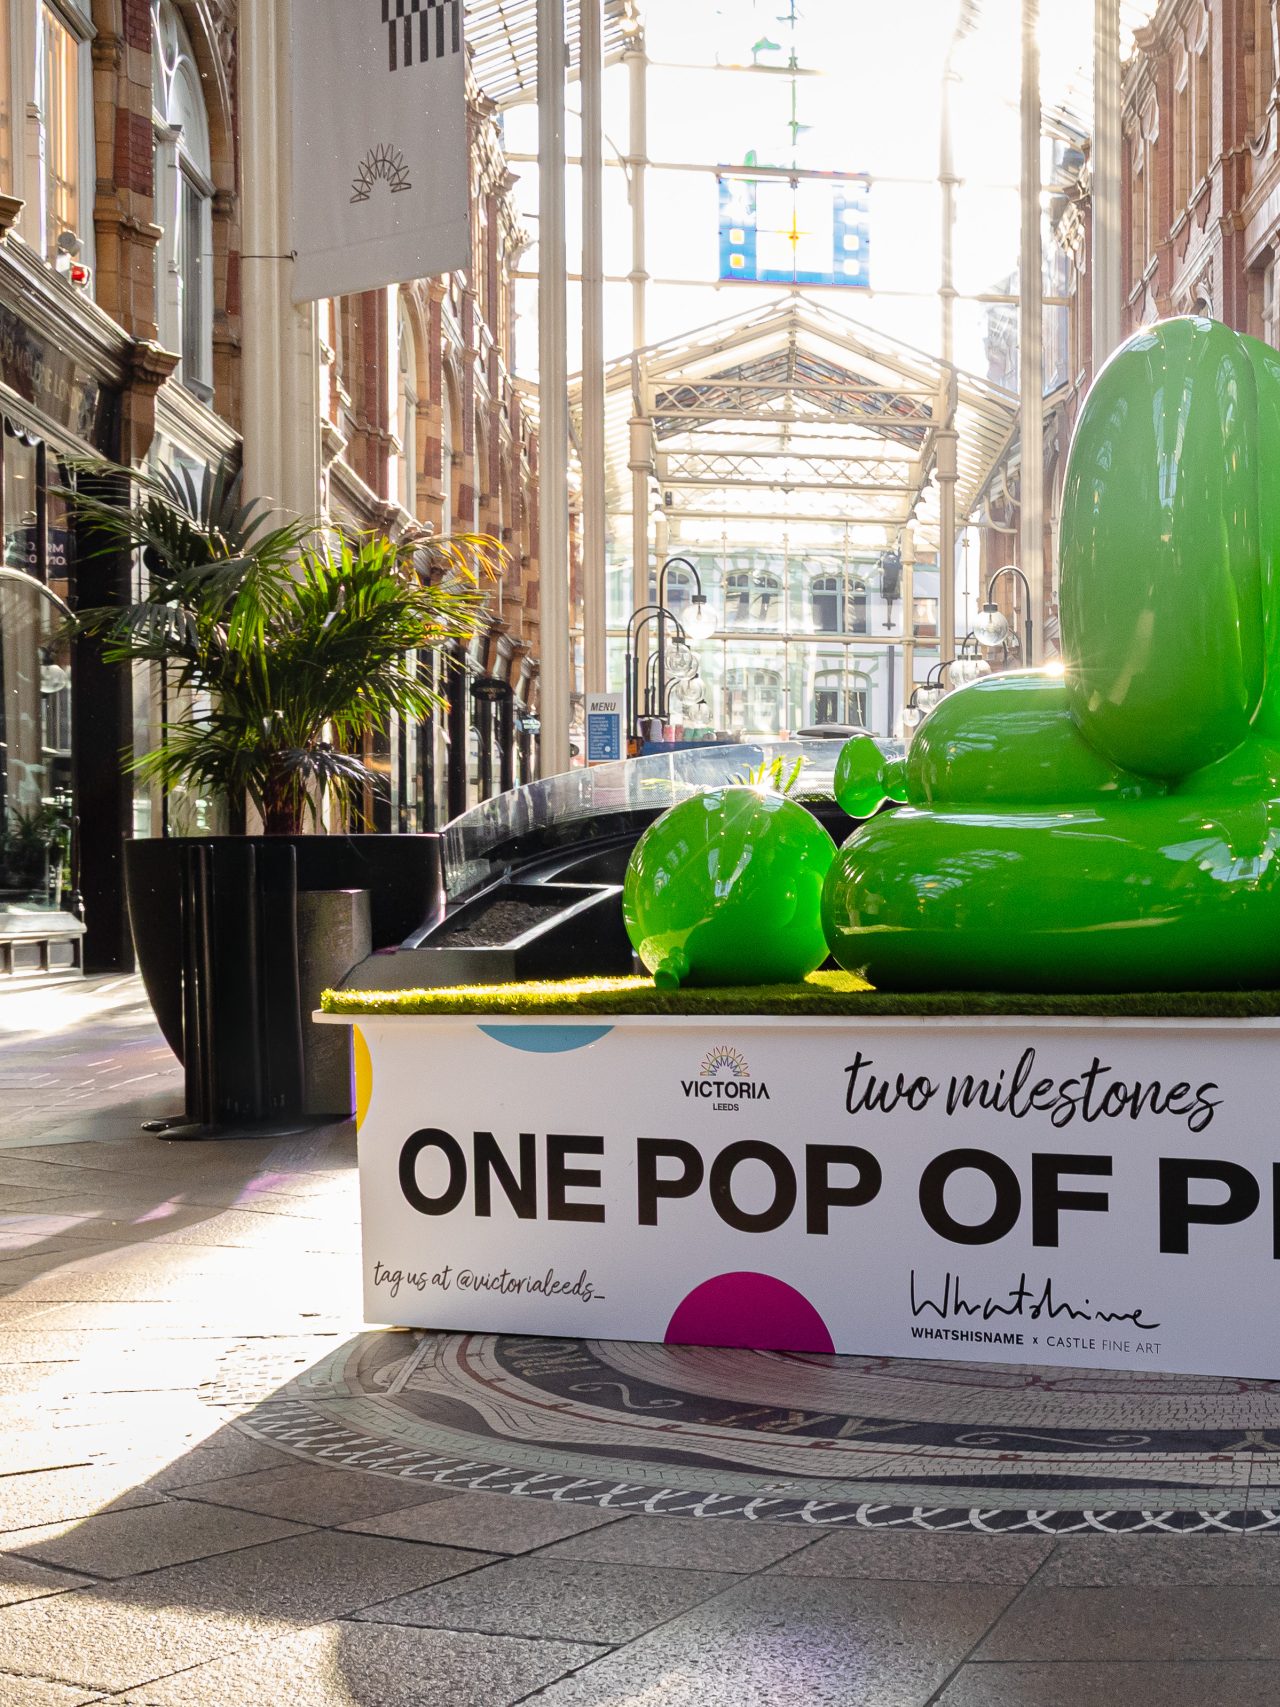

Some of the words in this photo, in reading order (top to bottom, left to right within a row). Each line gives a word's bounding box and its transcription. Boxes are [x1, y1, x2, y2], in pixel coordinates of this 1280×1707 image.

[590, 702, 617, 712] MENU
[681, 1080, 771, 1099] VICTORIA
[844, 1050, 941, 1115] two
[945, 1047, 1225, 1134] milestones
[712, 1103, 739, 1111] LEEDS
[399, 1128, 606, 1223] ONE
[636, 1137, 883, 1236] POP
[918, 1147, 1114, 1248] OF
[374, 1260, 405, 1298] tag
[406, 1272, 429, 1291] us
[431, 1265, 453, 1290] at
[456, 1269, 606, 1303] @victorialeeds_
[911, 1326, 1024, 1345] WHATSHISNAME
[1046, 1335, 1096, 1350] CASTLE
[1101, 1339, 1130, 1352] FINE
[1135, 1341, 1162, 1354] ART
